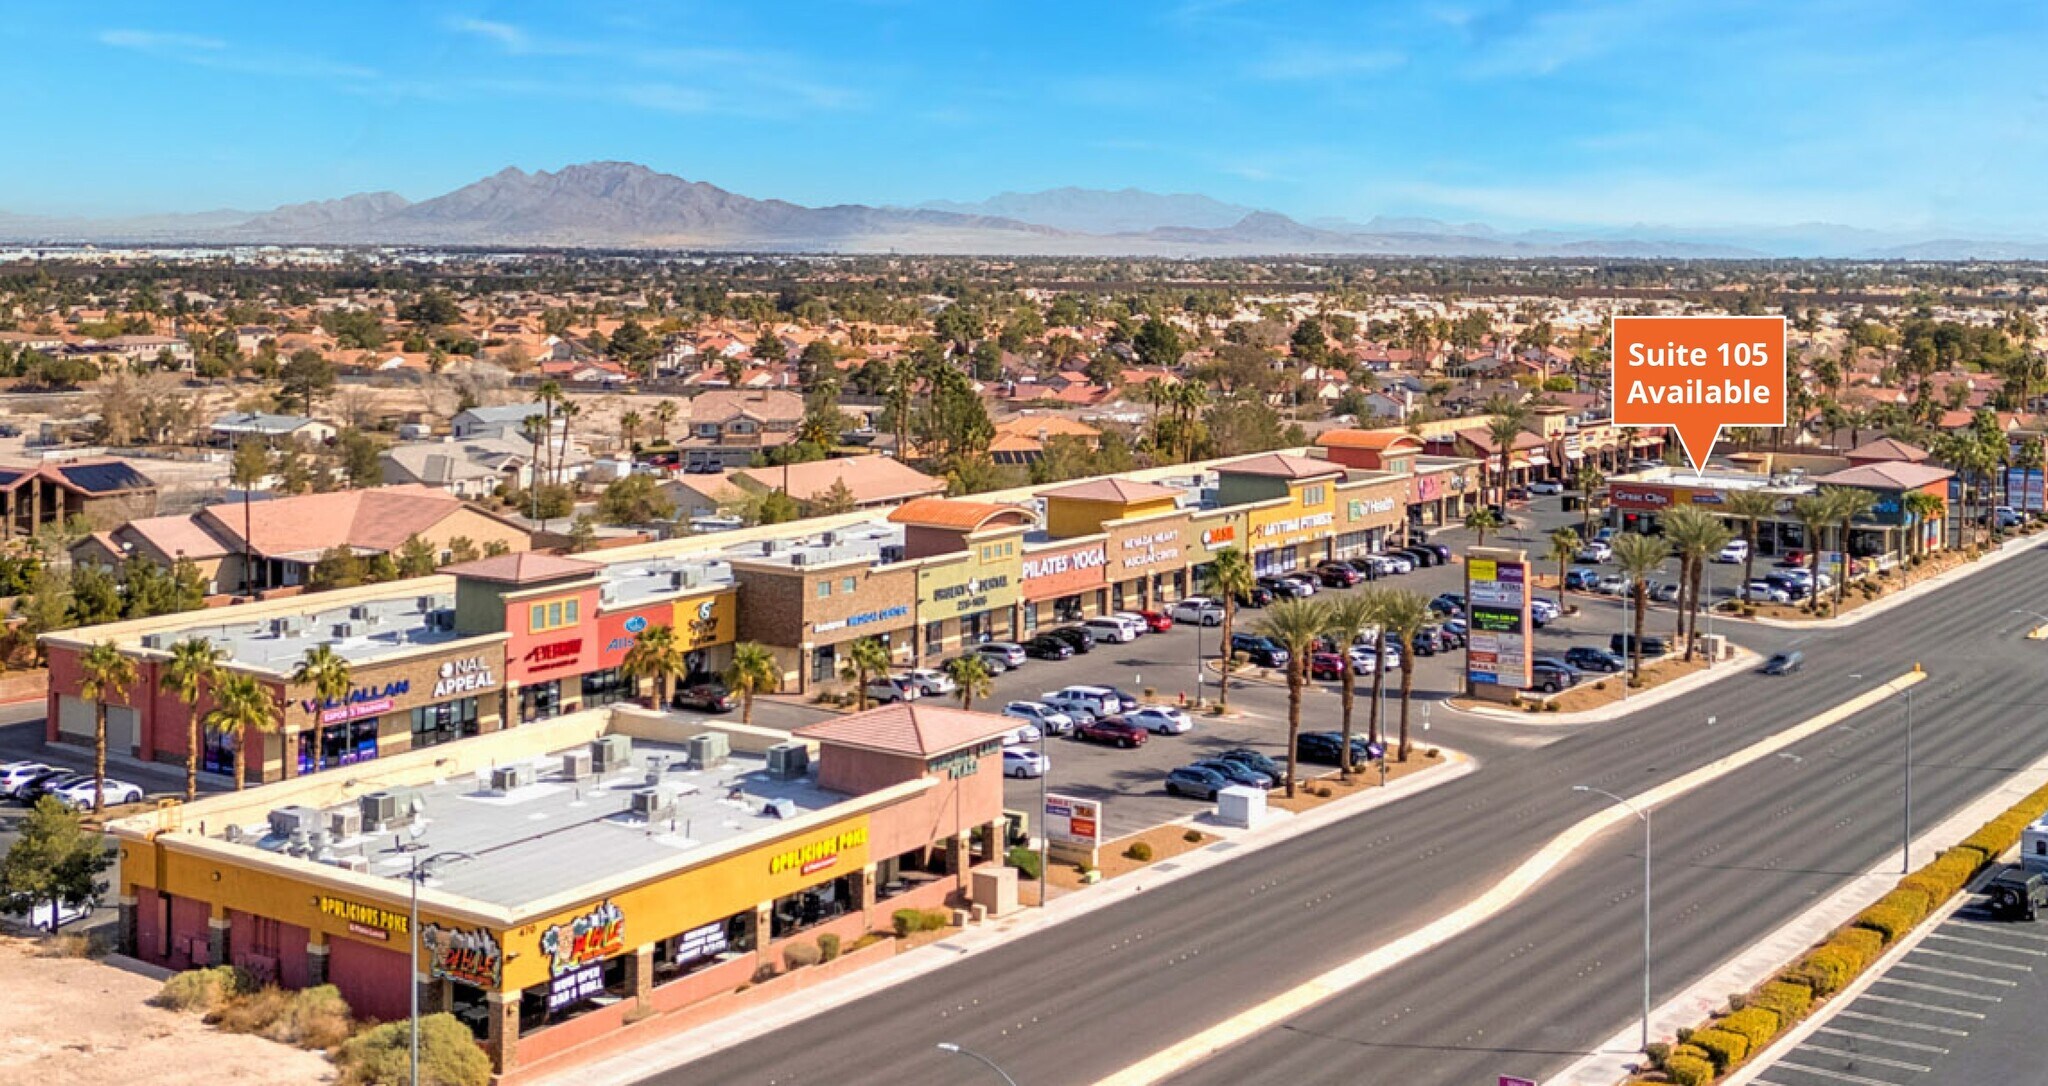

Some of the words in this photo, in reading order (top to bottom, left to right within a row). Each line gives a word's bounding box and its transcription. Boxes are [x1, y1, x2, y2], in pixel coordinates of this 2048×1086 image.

[1022, 555, 1068, 580] PILATES
[1071, 547, 1107, 571] YOGA
[455, 656, 491, 675] NAIL
[301, 678, 410, 714] VLALLAN
[433, 671, 497, 699] APPEAL
[320, 896, 379, 927] OPULICIOUS
[379, 910, 410, 933] POKE
